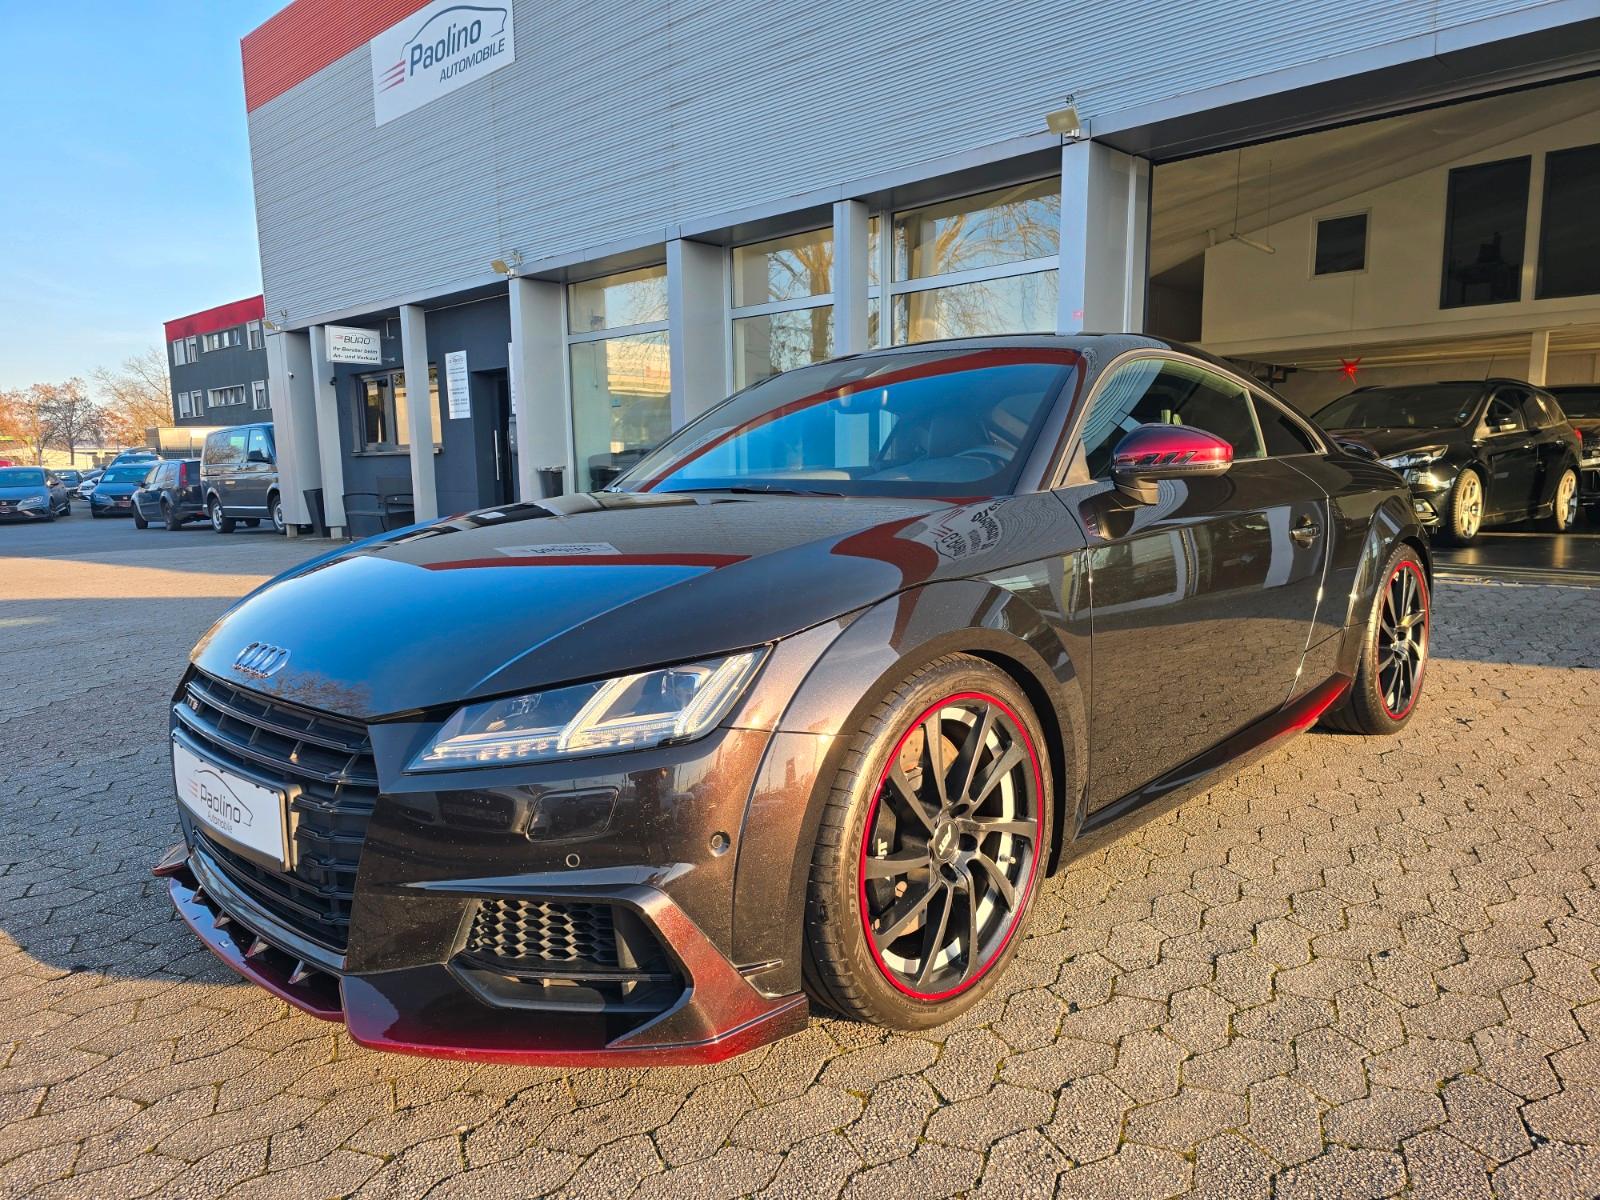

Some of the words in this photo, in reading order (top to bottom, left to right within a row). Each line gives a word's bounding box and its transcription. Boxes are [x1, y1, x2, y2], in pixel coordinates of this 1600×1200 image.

[410, 19, 482, 77] Paolino
[439, 38, 505, 83] AUTOMOBILE
[343, 334, 371, 345] BÜRO
[201, 784, 241, 823] Paolino
